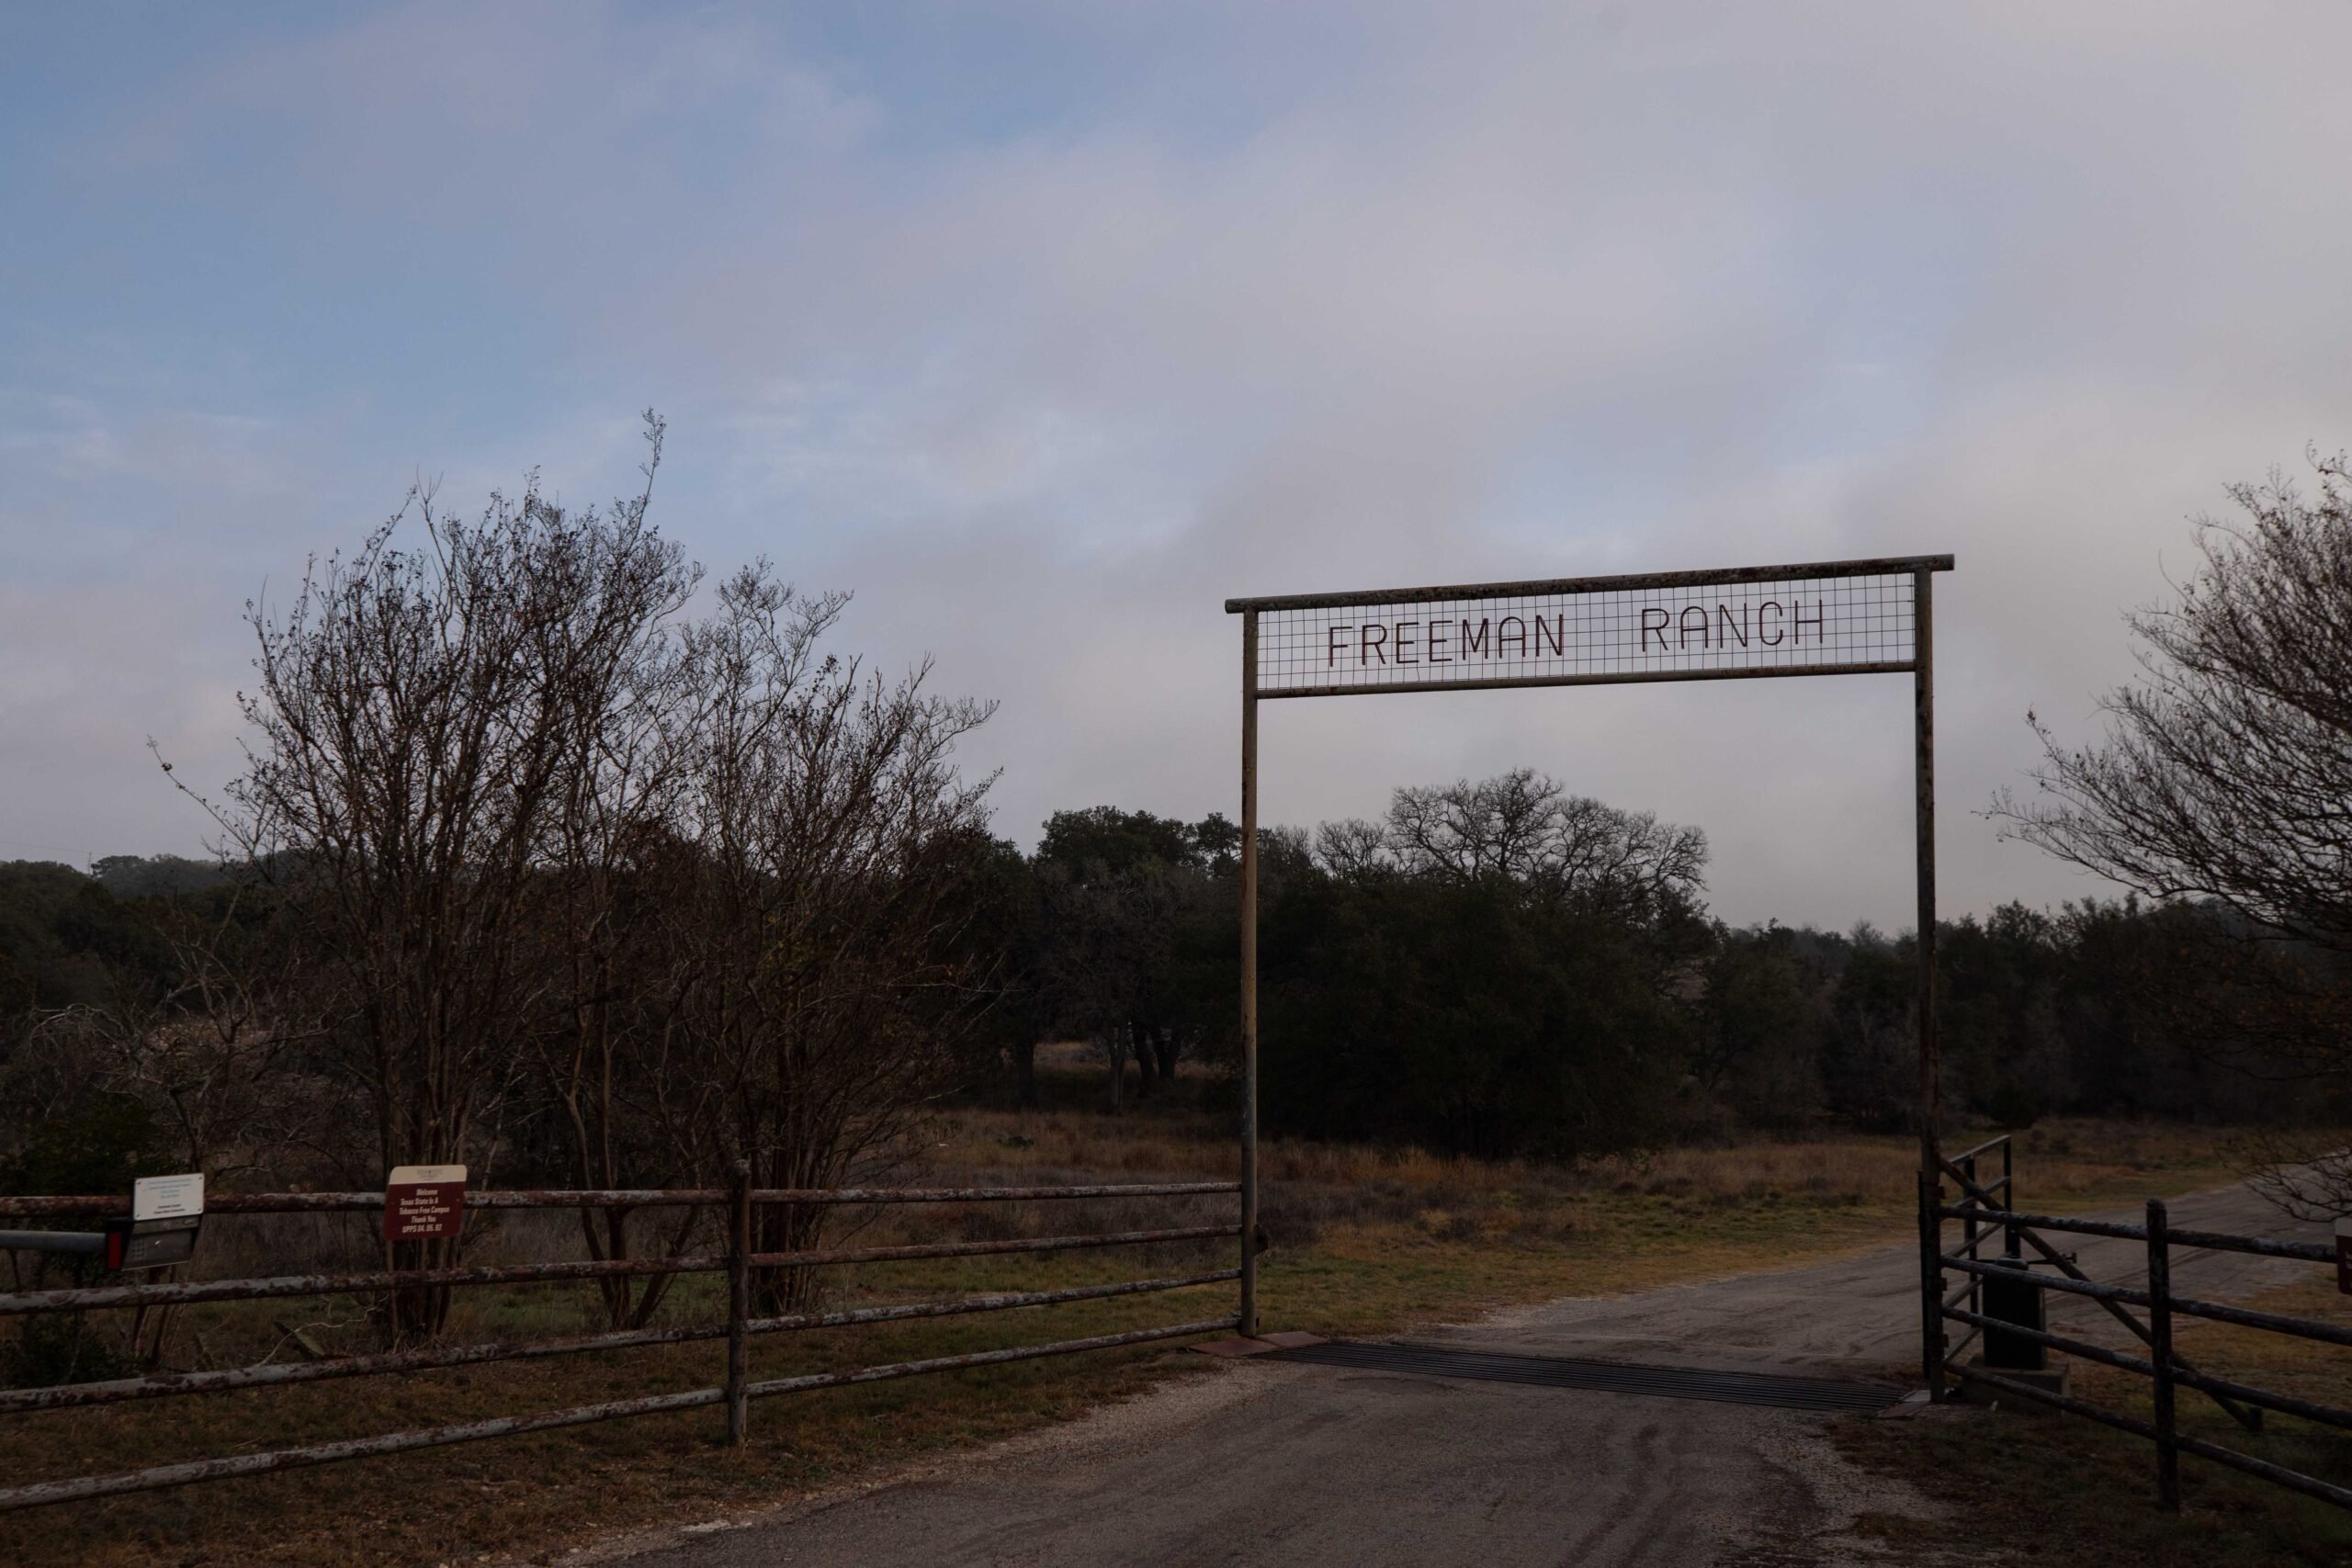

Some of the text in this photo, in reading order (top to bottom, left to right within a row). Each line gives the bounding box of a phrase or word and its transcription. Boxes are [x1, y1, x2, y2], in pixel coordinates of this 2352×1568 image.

[1329, 599, 1823, 667] FREEMAN RANCH
[431, 1206, 450, 1214] Campus
